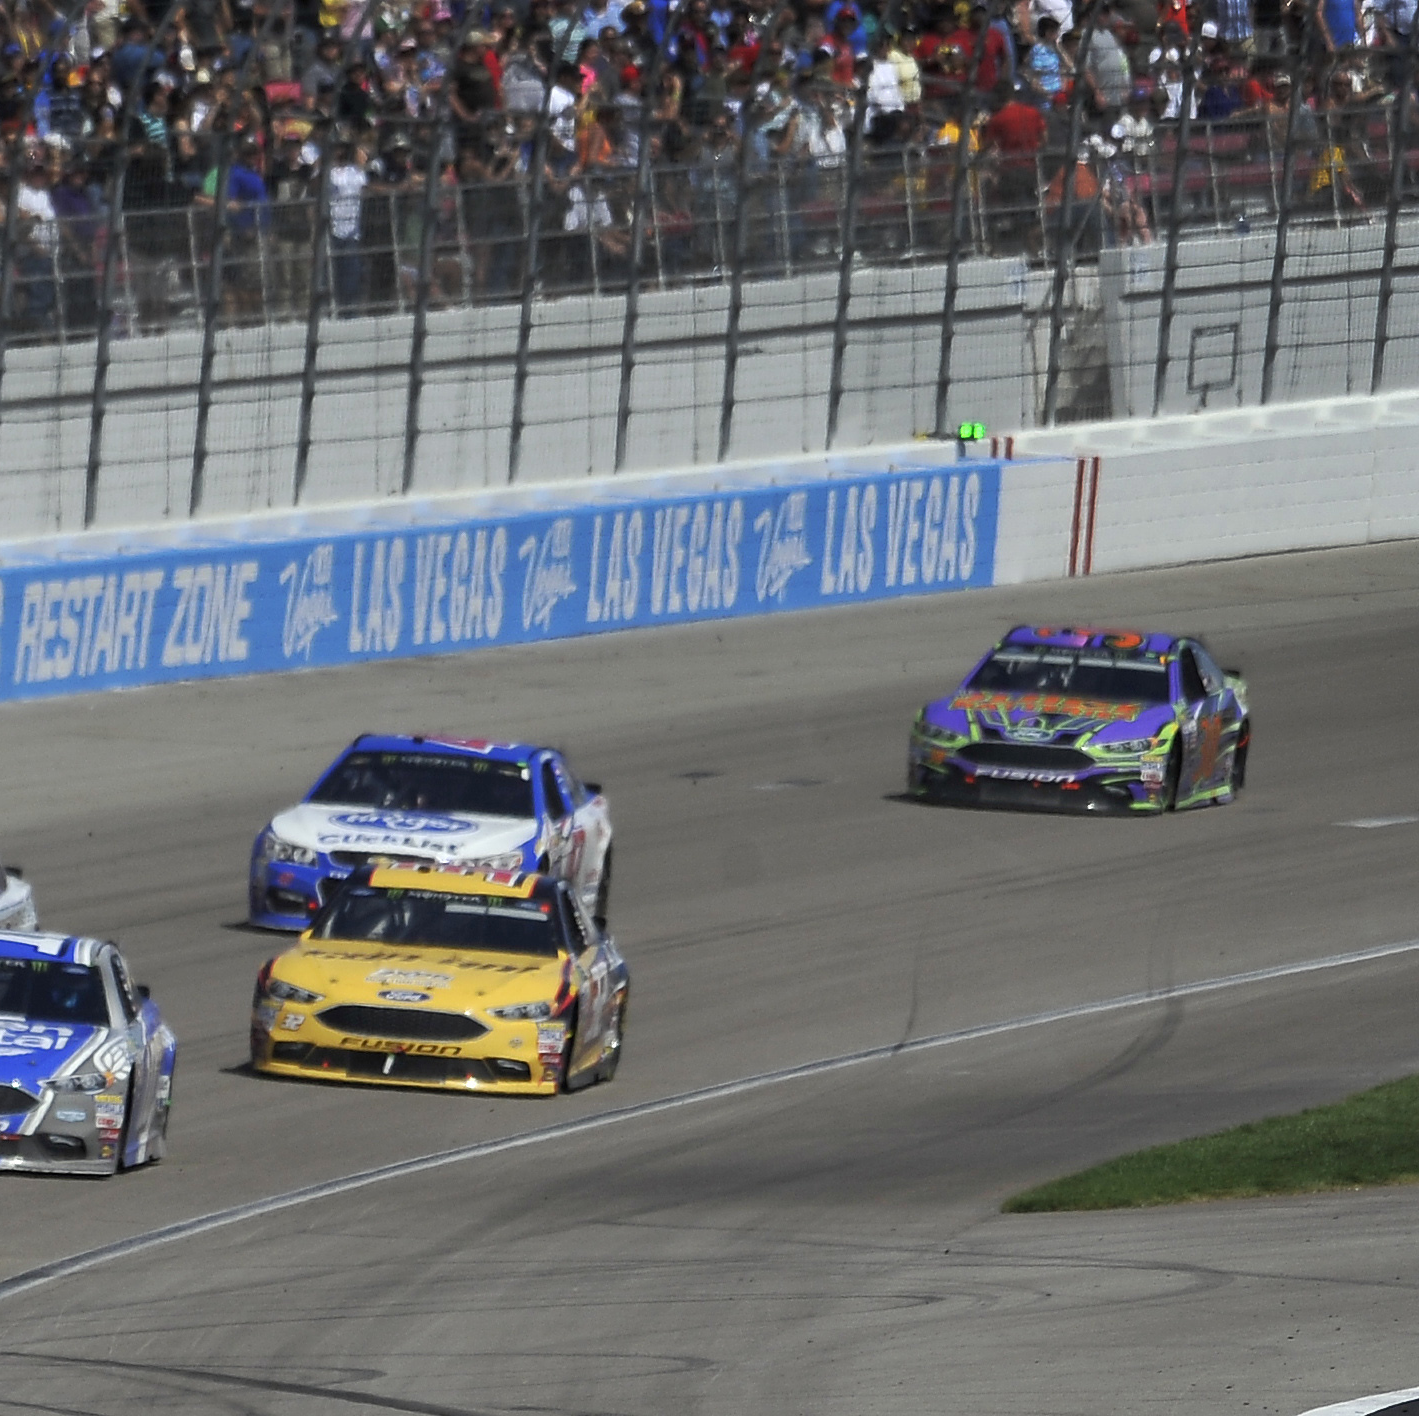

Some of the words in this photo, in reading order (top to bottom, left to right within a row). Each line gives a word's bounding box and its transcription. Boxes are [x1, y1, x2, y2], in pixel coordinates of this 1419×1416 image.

[349, 537, 406, 652] LAS
[413, 526, 507, 645] VEGAS
[586, 510, 643, 622] LAS
[650, 499, 743, 615] VEGAS
[821, 484, 877, 595] LAS
[885, 472, 980, 587] VEGAS
[13, 570, 164, 684] RESTART
[162, 562, 259, 667] ZONE
[339, 1037, 463, 1056] FUSION
